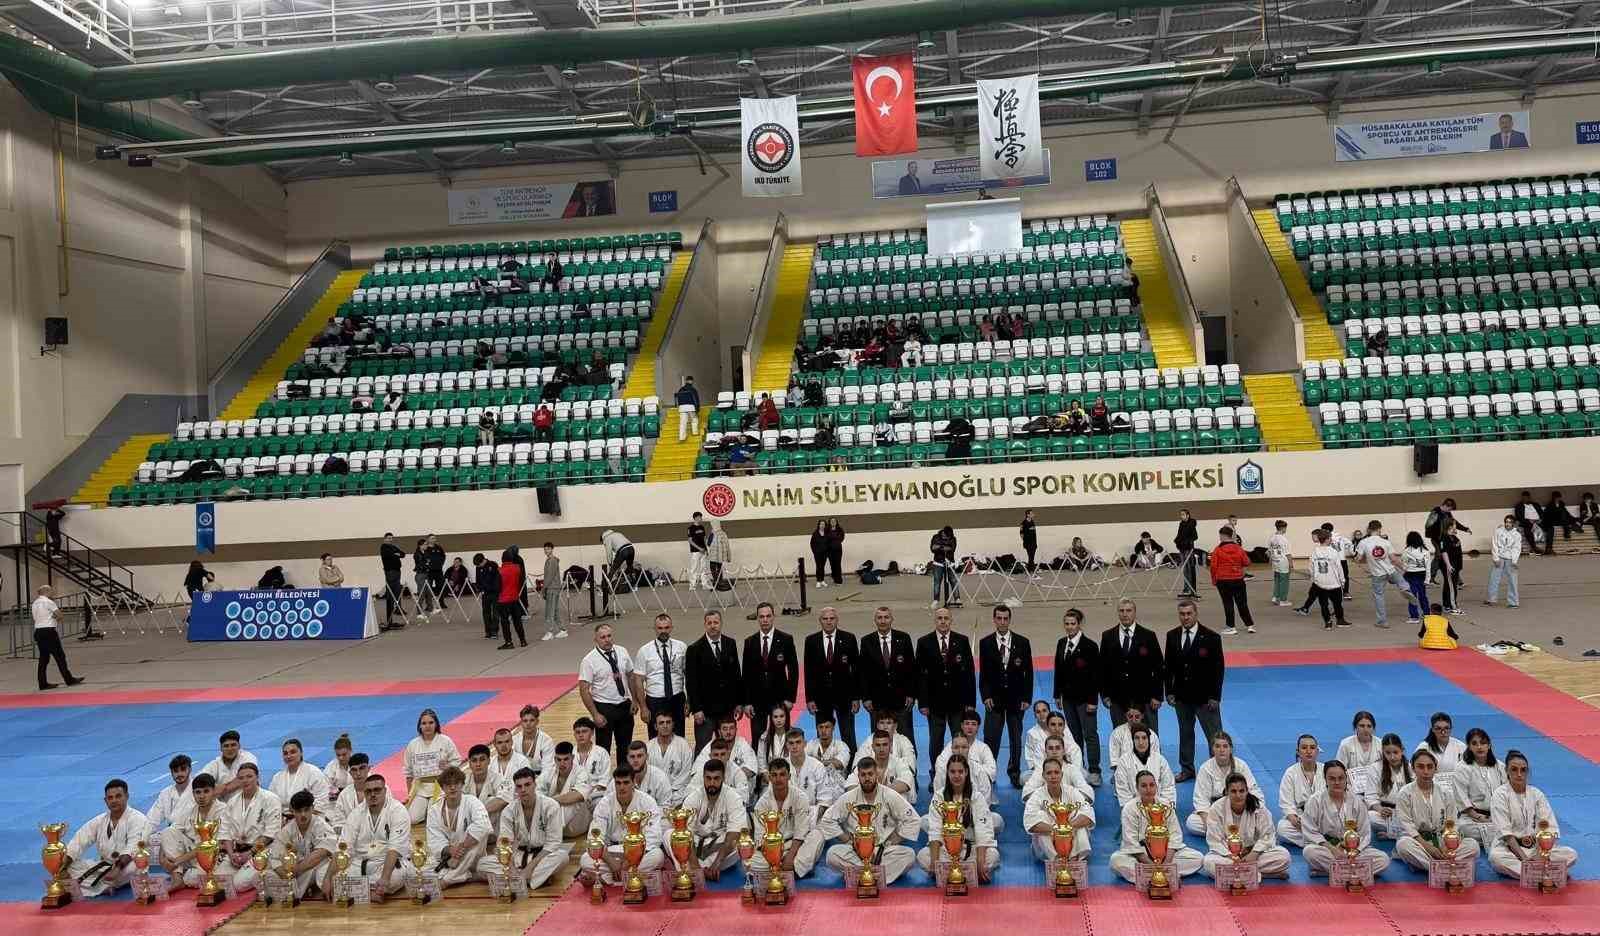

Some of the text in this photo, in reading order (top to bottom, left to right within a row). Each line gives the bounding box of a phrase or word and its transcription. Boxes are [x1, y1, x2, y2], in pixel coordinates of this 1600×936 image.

[1430, 119, 1465, 127] KATILAN
[1466, 116, 1484, 124] TÜM
[1581, 123, 1600, 132] BLO
[1367, 131, 1400, 139] SPORCU
[1089, 160, 1112, 170] BLOK
[1095, 170, 1108, 178] 102
[653, 192, 673, 202] BLOK
[743, 463, 1224, 508] NAİM SÜLEYMANOĞLU SPOR KOMPLEKSİ
[239, 589, 320, 599] YILDIRIM BELEDİYESİ
